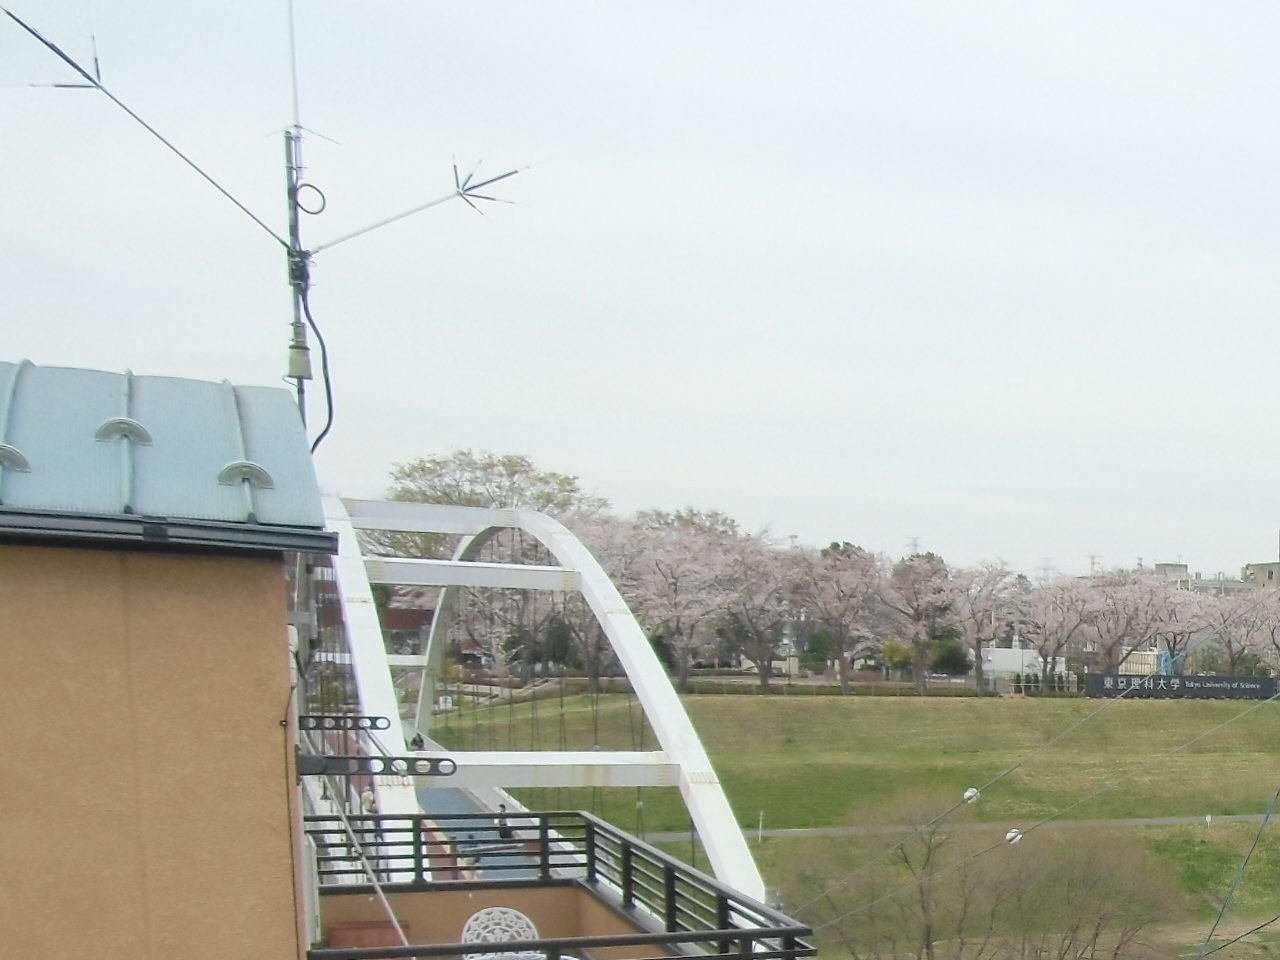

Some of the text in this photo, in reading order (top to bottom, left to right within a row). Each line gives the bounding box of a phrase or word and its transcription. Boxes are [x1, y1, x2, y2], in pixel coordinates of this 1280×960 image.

[1103, 676, 1181, 690] 東京理科大学
[1184, 681, 1201, 690] Tokyo
[1202, 681, 1230, 690] University
[1231, 681, 1239, 689] of
